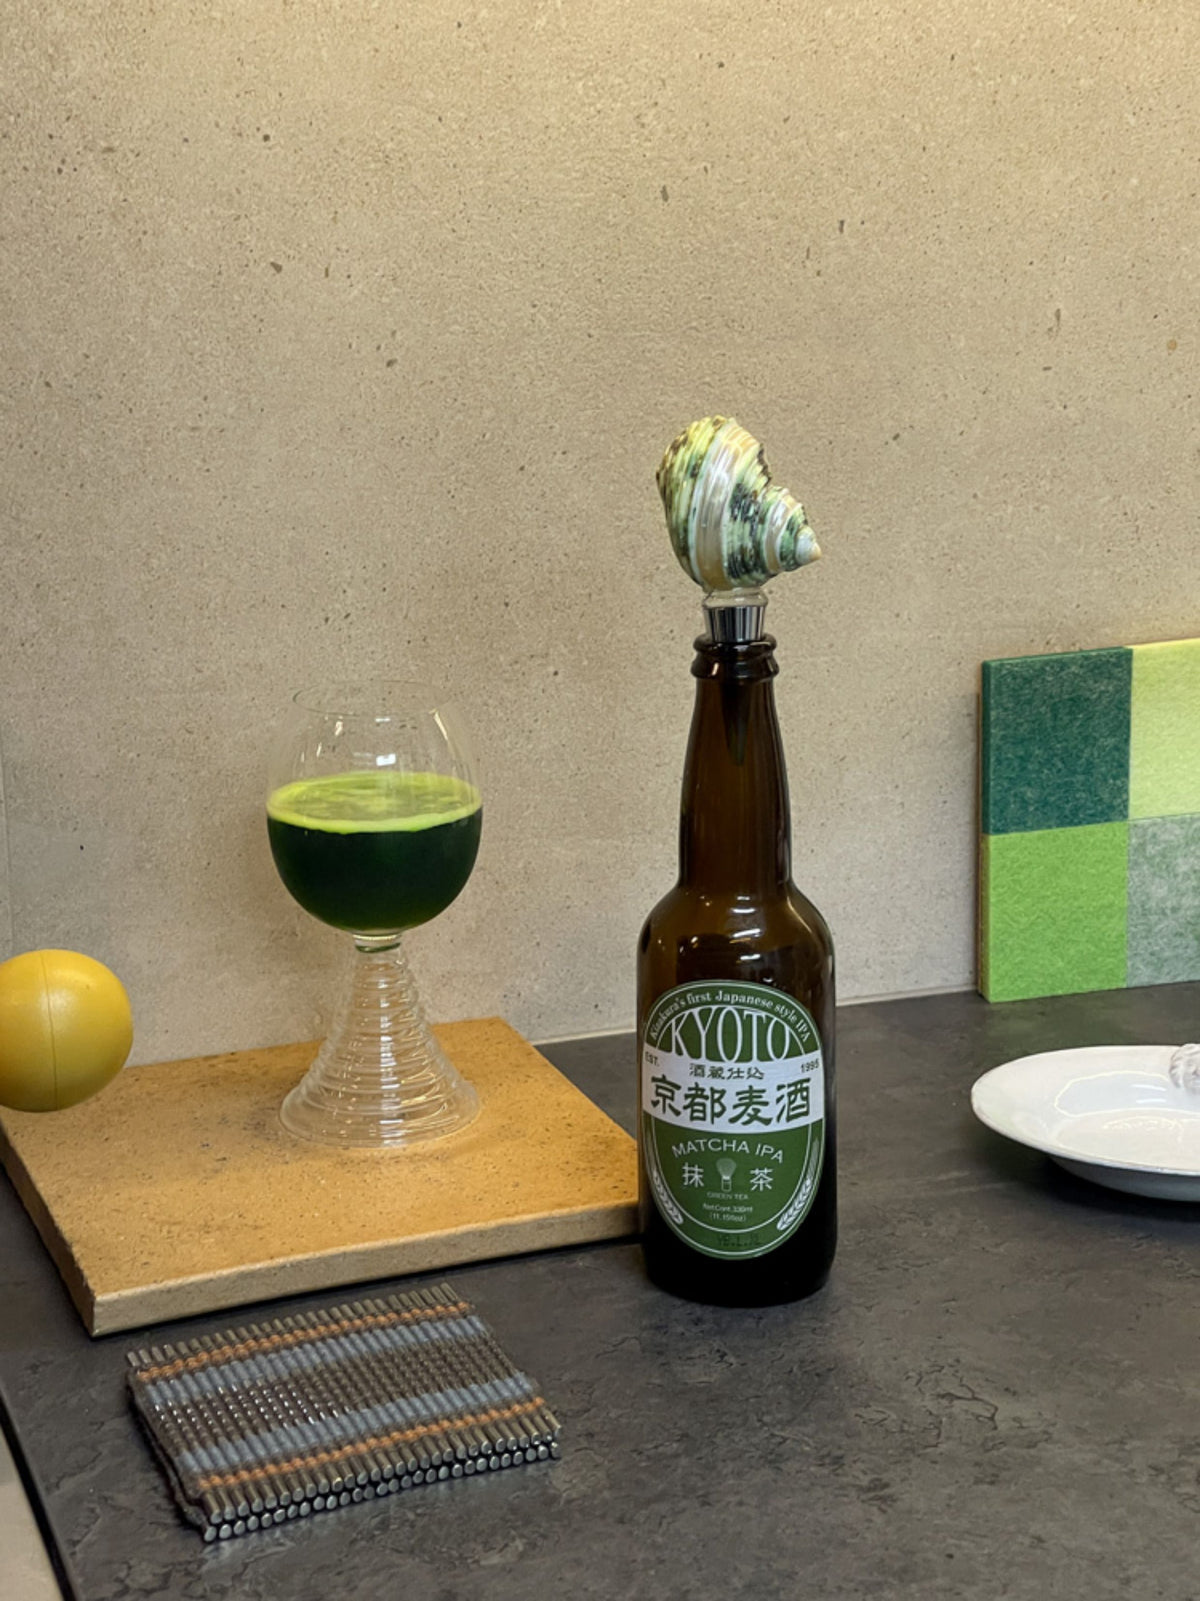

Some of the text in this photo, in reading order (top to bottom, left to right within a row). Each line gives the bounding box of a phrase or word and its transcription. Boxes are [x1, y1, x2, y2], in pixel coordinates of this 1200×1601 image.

[671, 1005, 791, 1063] KYOTO
[686, 992, 711, 1005] first
[715, 990, 774, 1008] Japanese
[774, 1003, 798, 1023] style
[795, 1018, 811, 1043] IPA
[651, 1074, 812, 1127] 京都麦酒
[672, 1138, 784, 1164] MATCHA IPA
